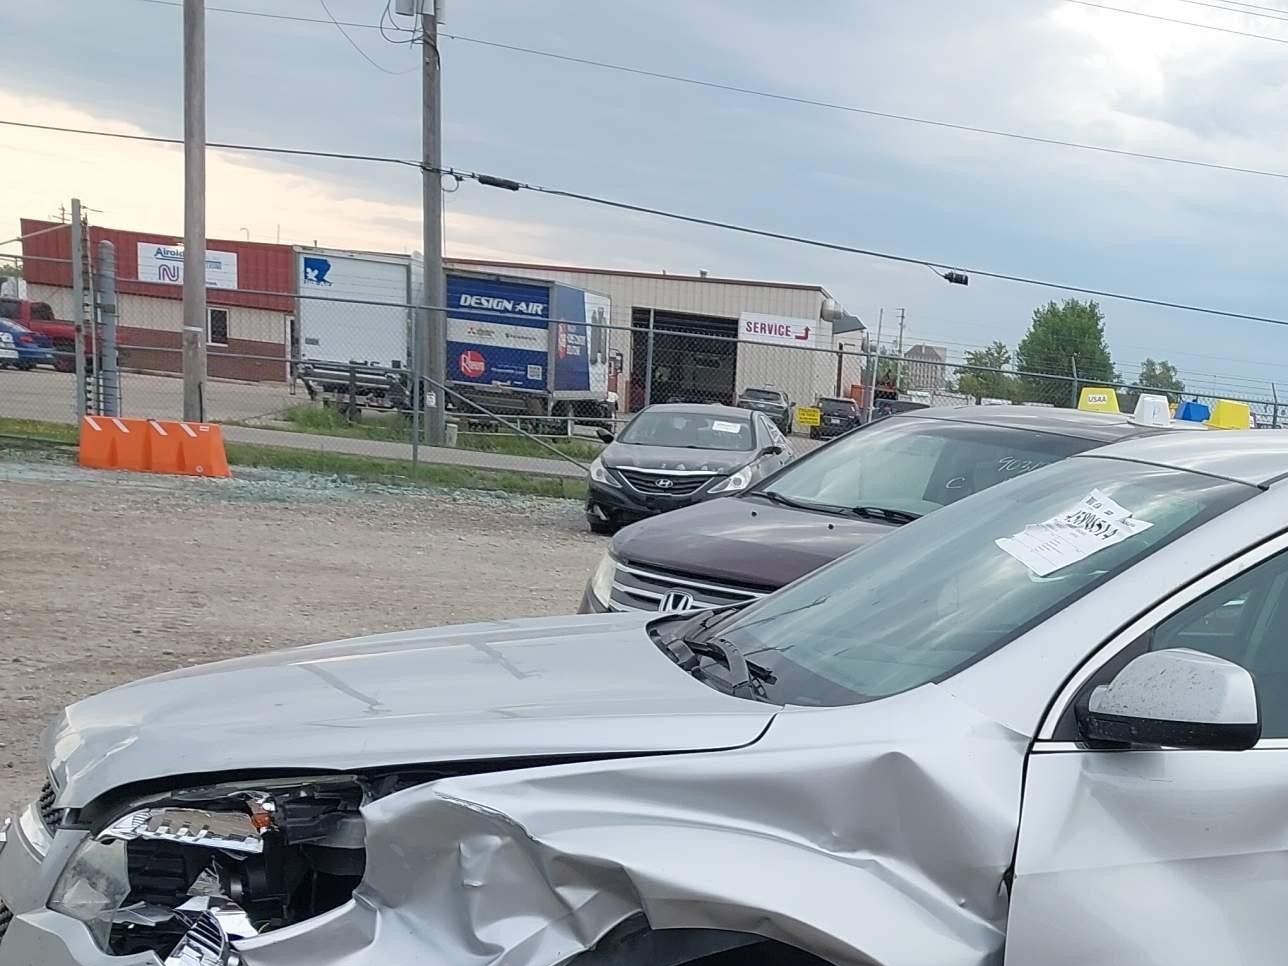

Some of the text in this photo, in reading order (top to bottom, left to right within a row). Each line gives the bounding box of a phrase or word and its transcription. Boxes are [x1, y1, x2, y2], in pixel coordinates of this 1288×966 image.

[460, 294, 544, 315] DESIGN AIR
[745, 320, 791, 337] SERVICE
